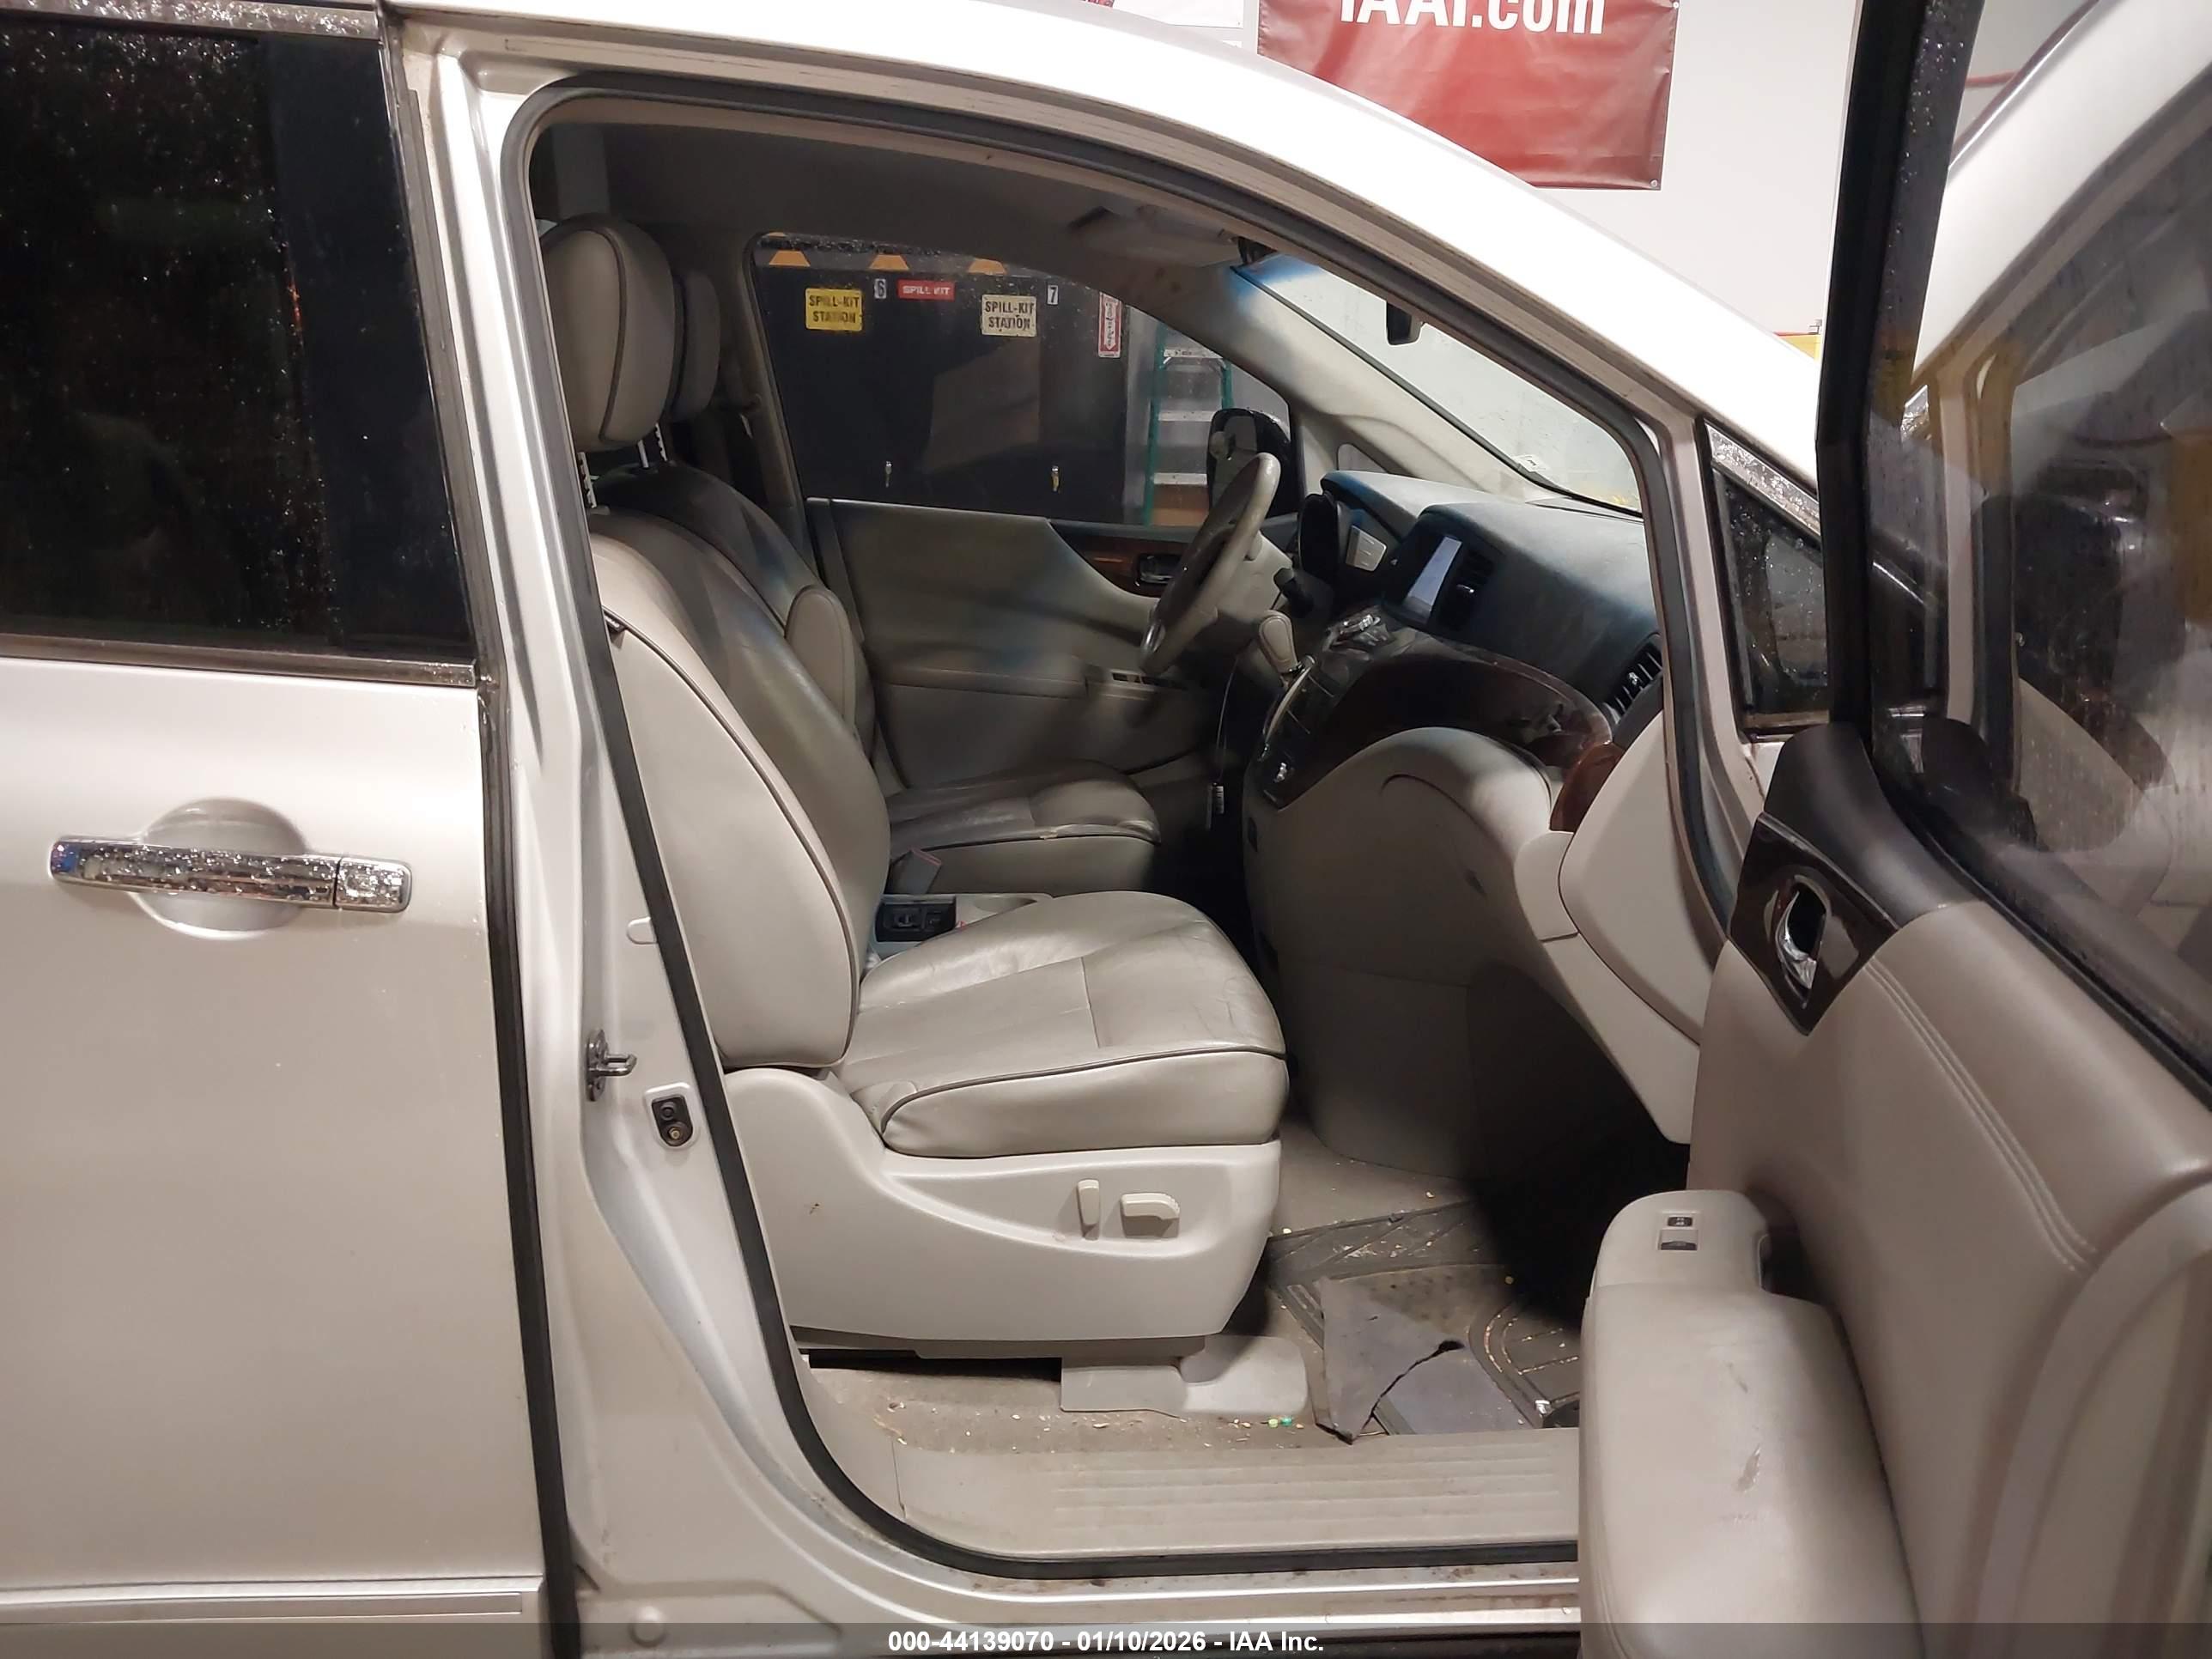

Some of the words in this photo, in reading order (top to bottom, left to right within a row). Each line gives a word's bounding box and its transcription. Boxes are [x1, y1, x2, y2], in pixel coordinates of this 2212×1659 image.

[878, 280, 886, 297] 6
[902, 285, 931, 295] SPILL
[933, 287, 950, 295] KIT
[1050, 287, 1057, 302] 7
[985, 301, 1034, 314] SPILL-KIT
[813, 311, 856, 323] STAON
[988, 316, 1030, 330] STATION
